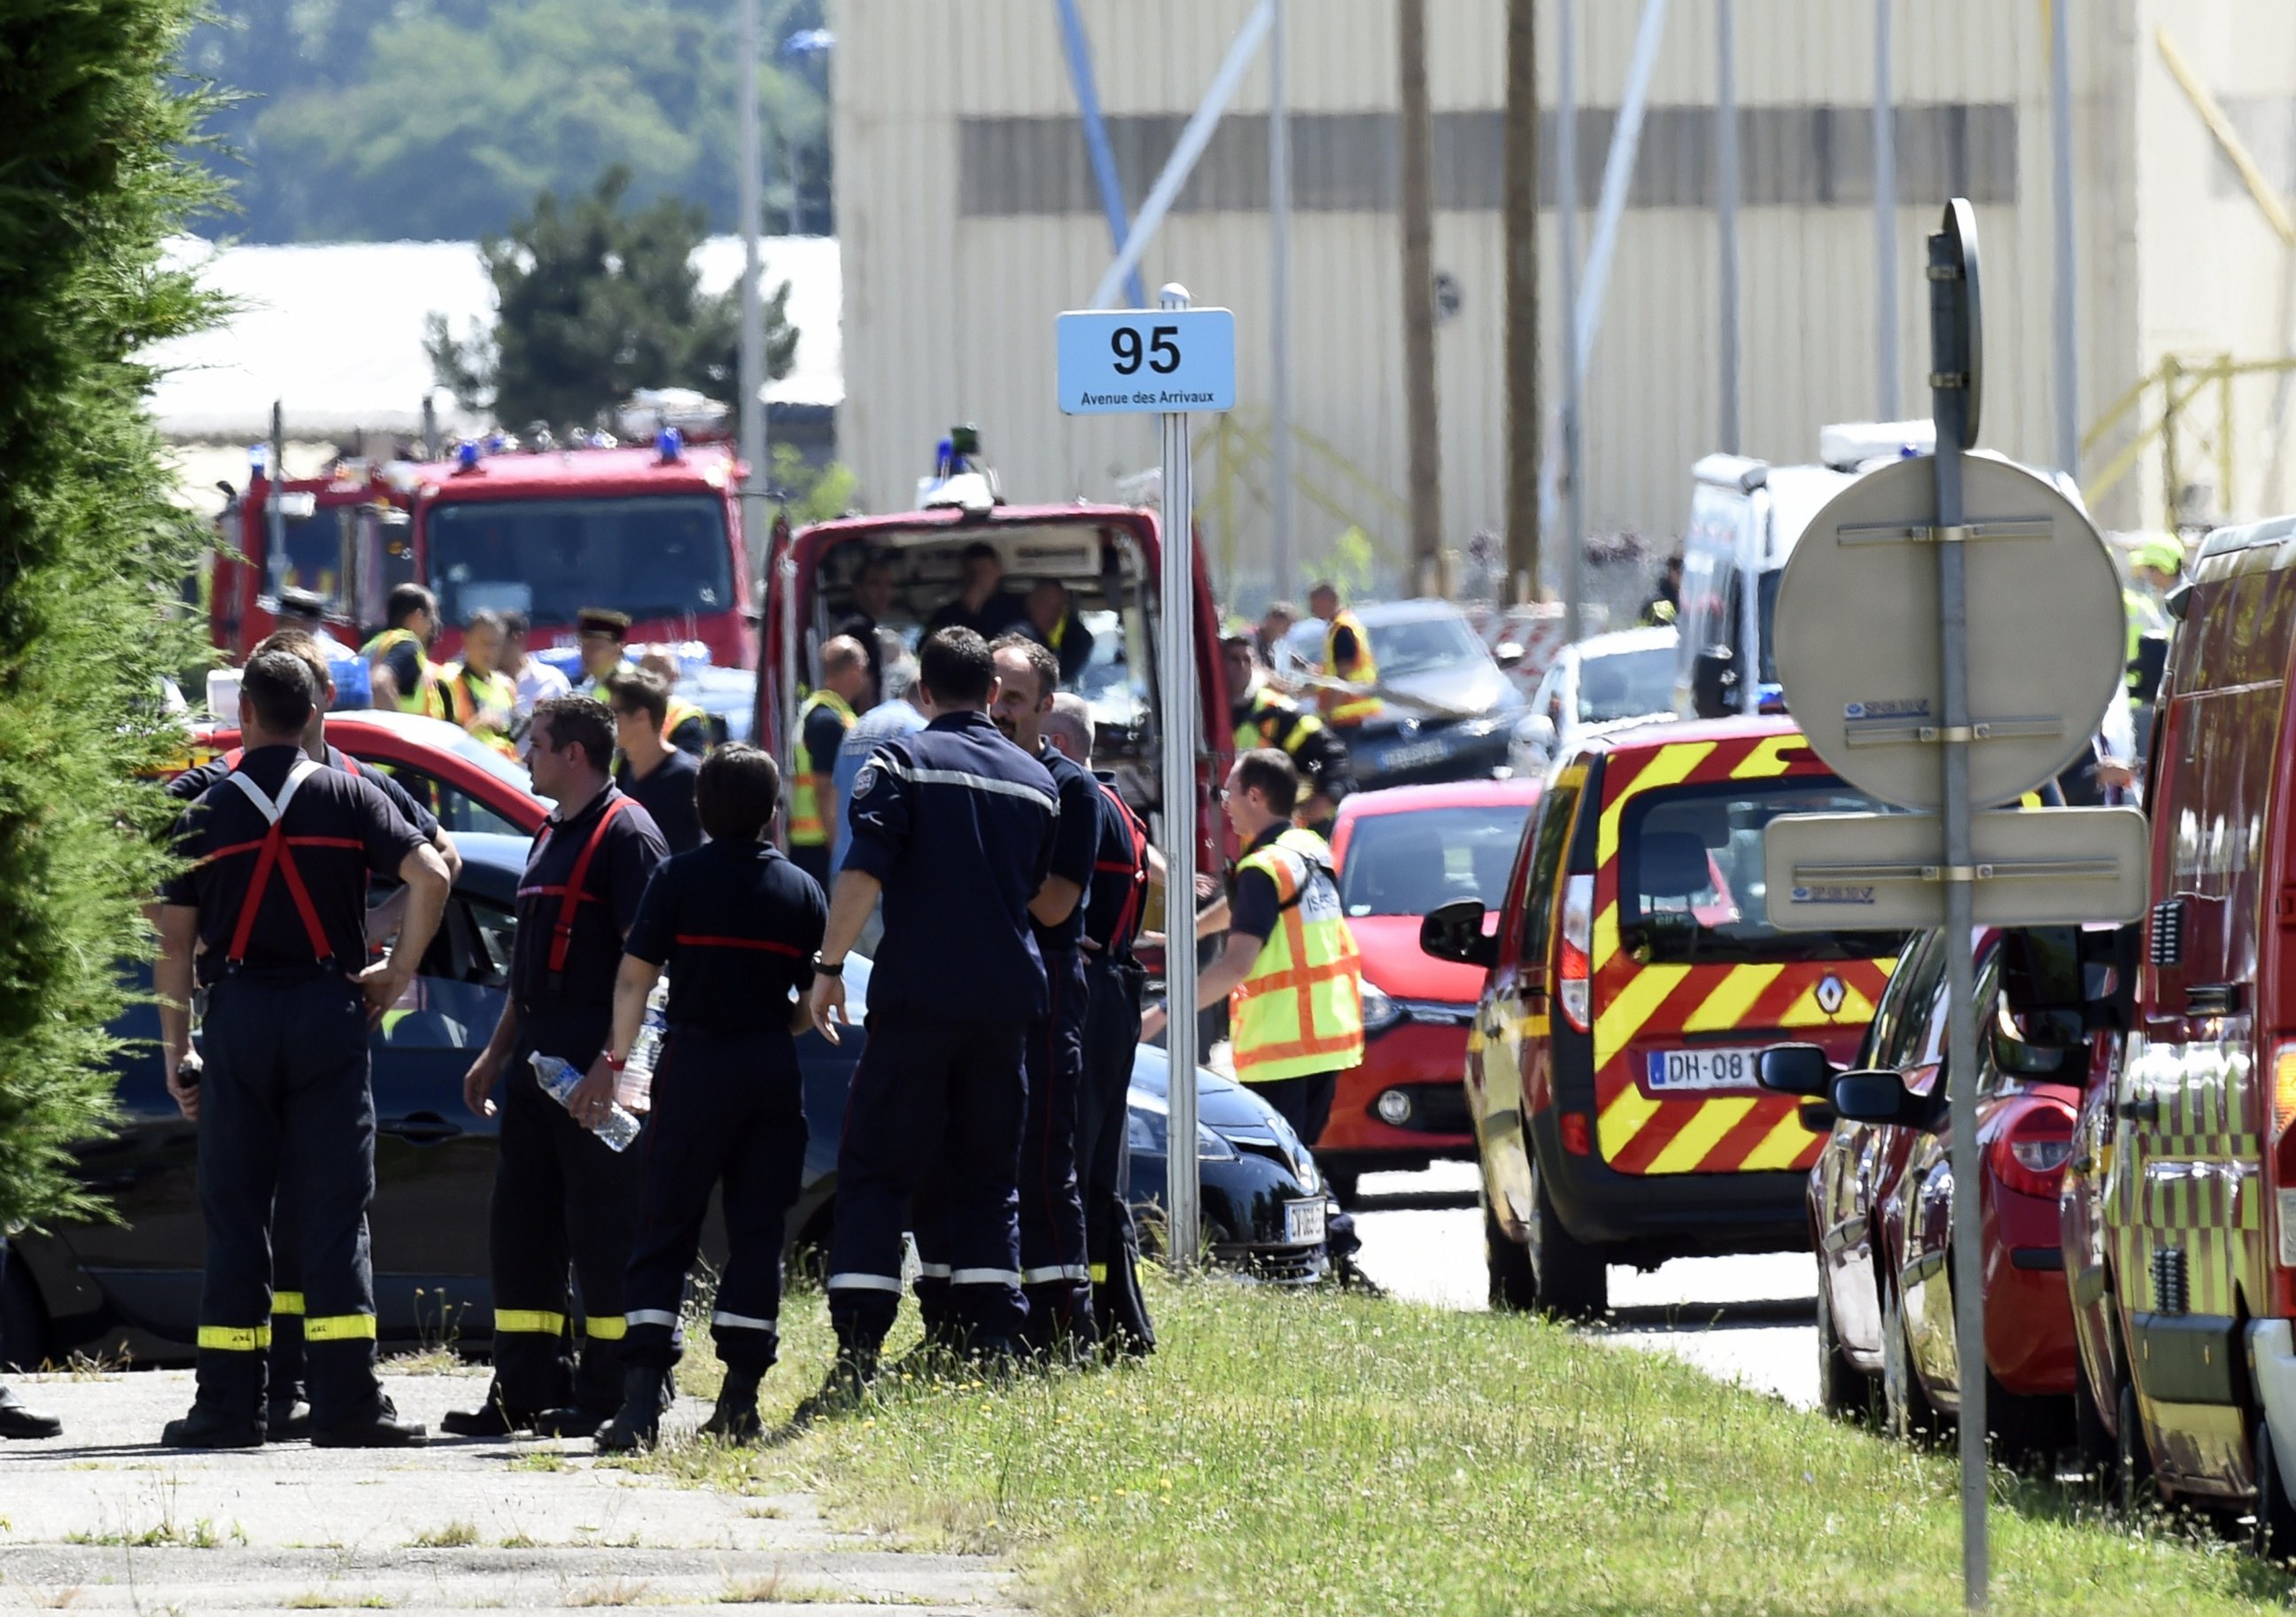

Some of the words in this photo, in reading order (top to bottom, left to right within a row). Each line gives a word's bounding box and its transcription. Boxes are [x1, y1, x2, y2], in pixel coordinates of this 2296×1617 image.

[1111, 326, 1181, 375] 95
[1081, 392, 1129, 406] Avenue
[1133, 391, 1156, 404] des
[1160, 390, 1214, 403] Arrivaux
